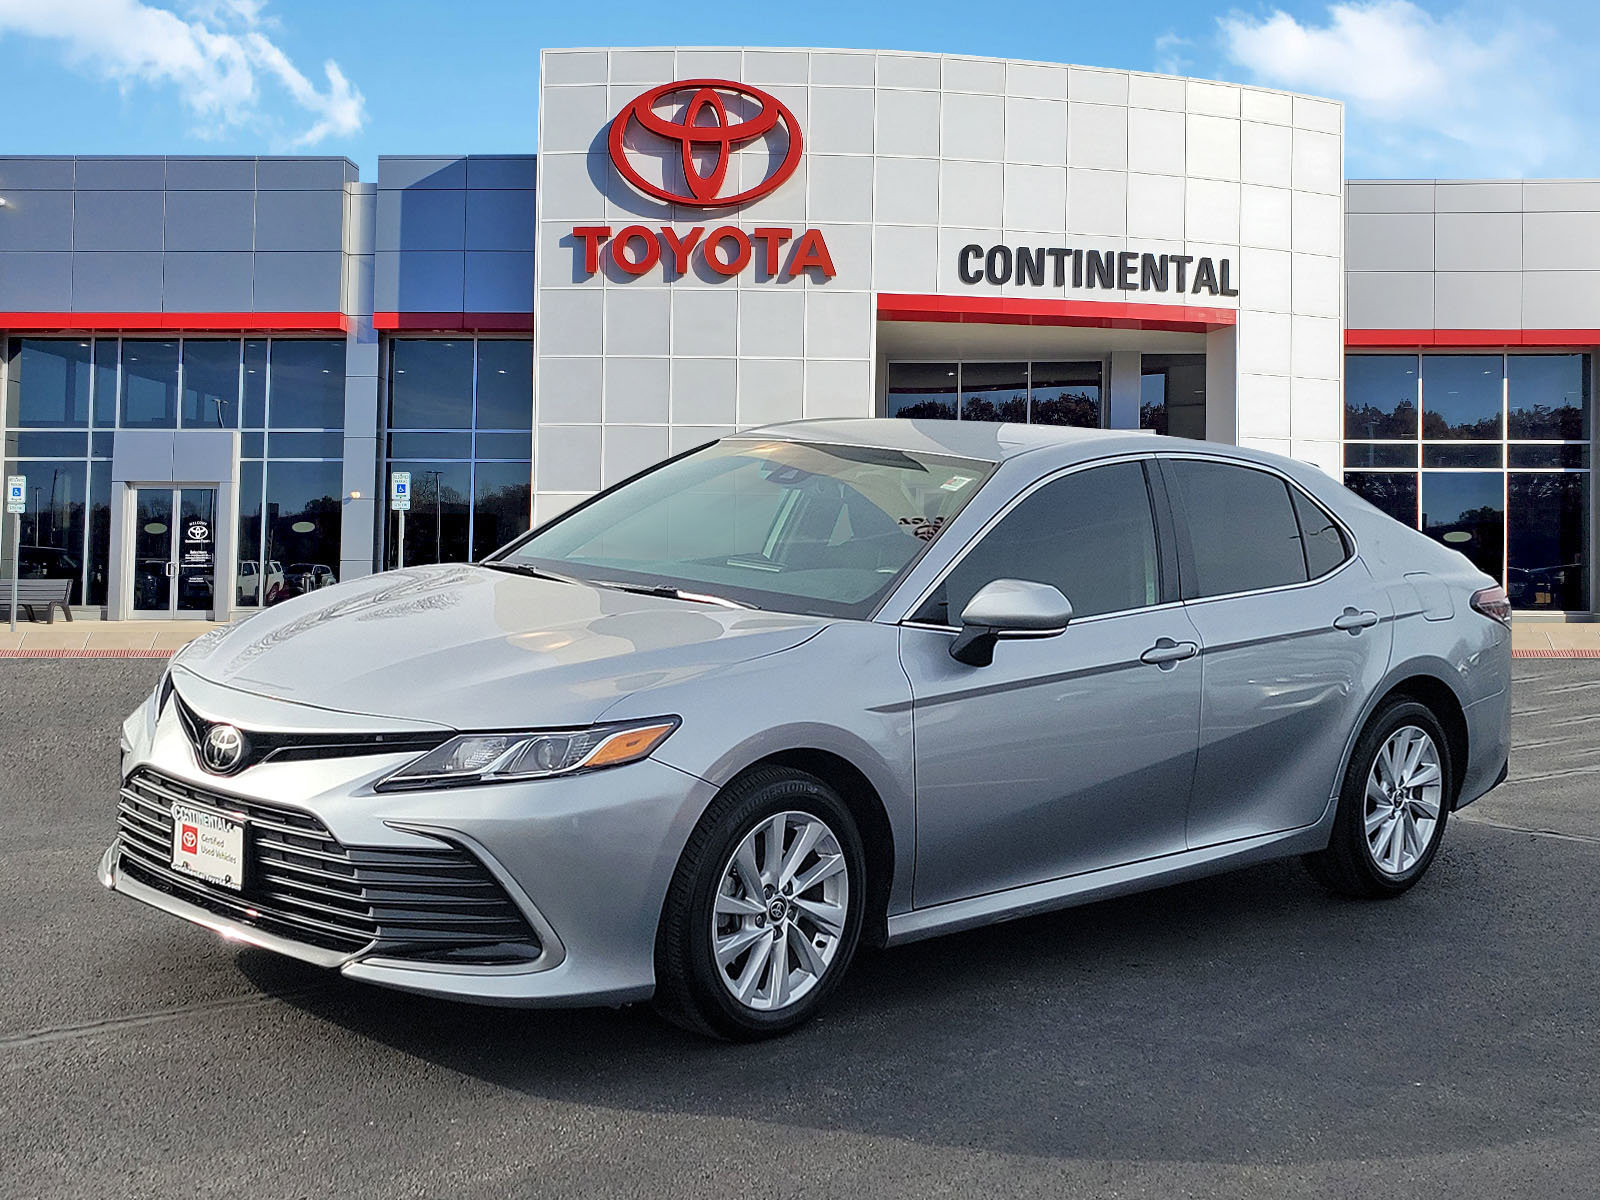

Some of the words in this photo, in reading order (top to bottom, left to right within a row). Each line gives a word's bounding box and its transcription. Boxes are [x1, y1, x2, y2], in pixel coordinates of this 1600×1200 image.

[573, 225, 835, 277] TOYOTA
[958, 243, 1239, 297] CONTINENTAL
[201, 834, 225, 848] Certified
[201, 846, 215, 857] Used
[215, 849, 237, 864] Vehicles
